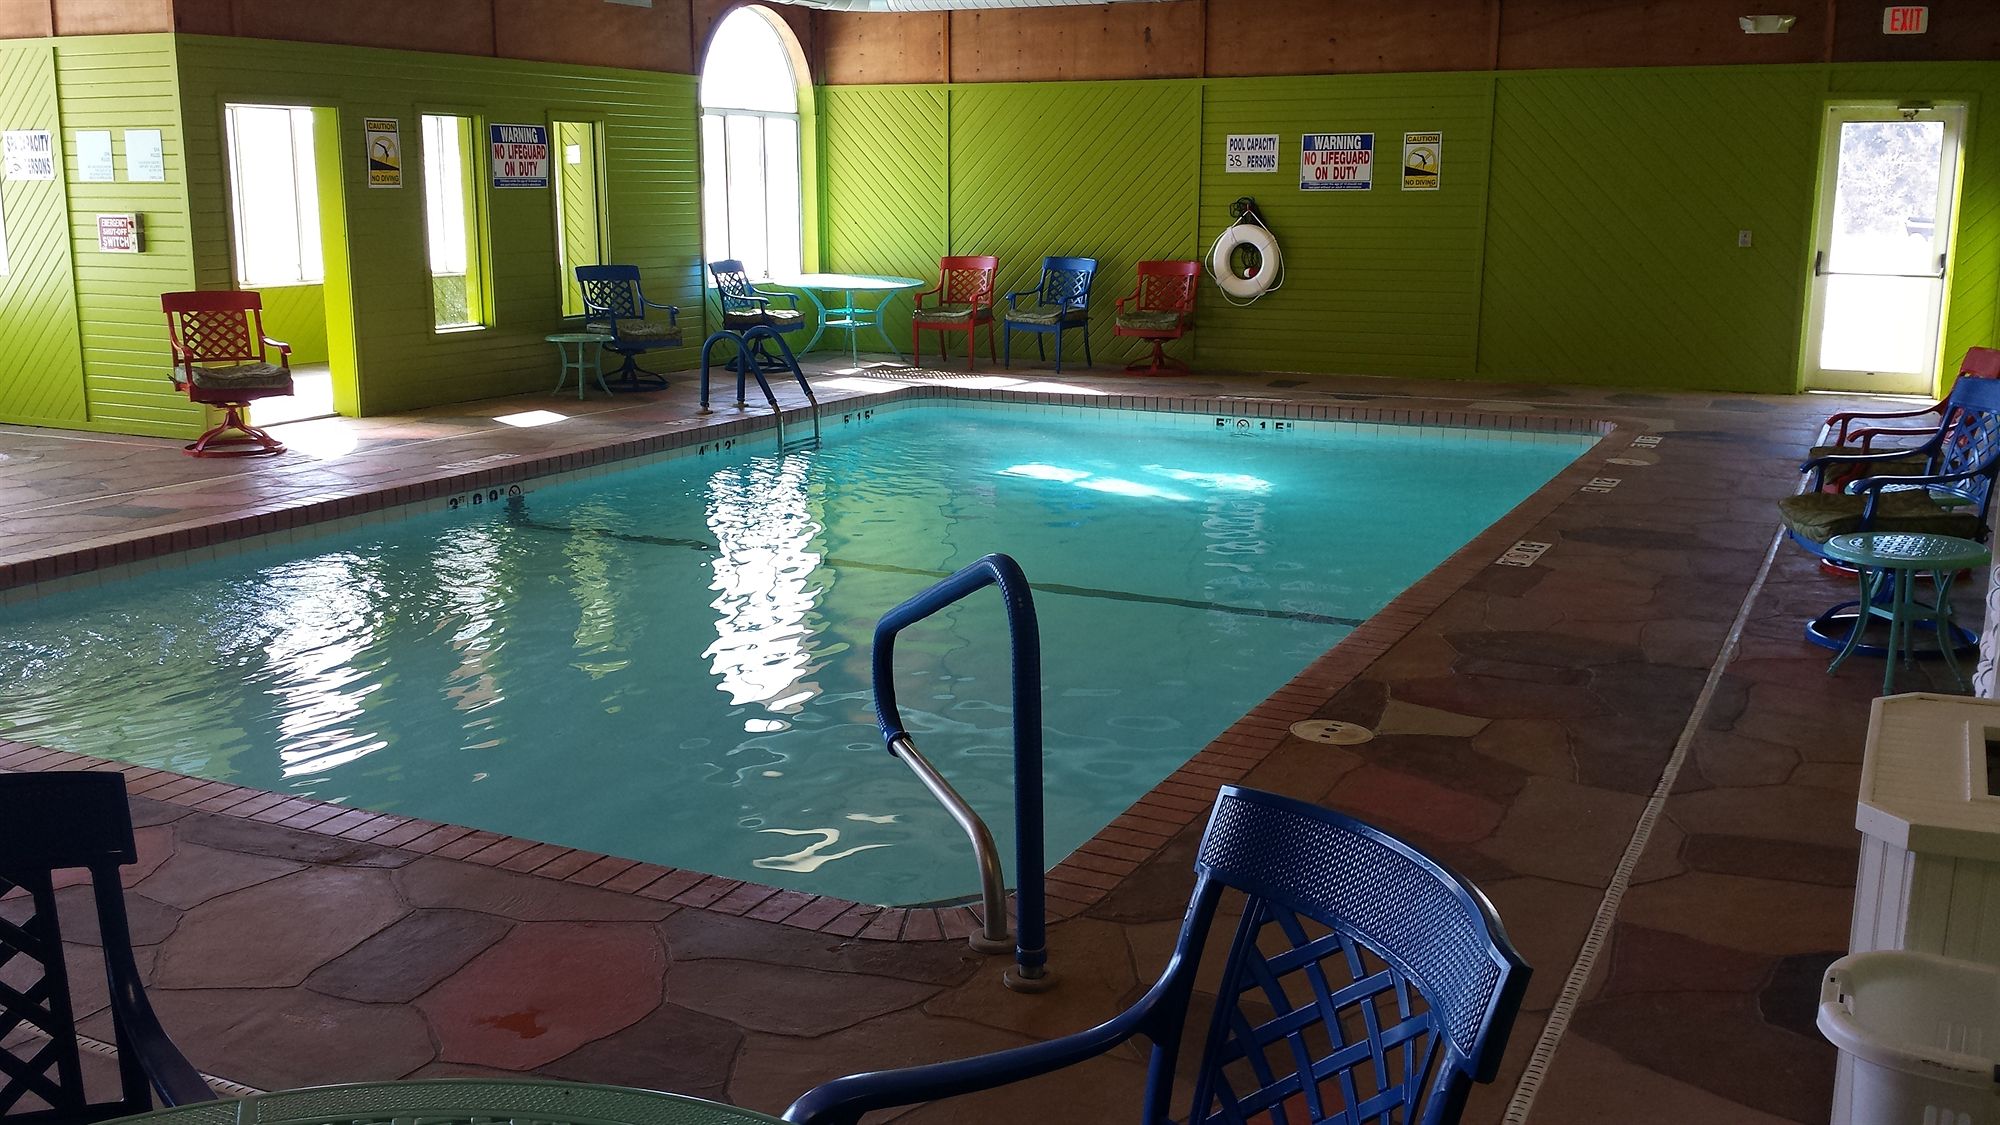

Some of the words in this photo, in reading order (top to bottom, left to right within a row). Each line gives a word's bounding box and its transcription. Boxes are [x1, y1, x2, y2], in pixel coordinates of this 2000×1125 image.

[1890, 8, 1923, 31] EXIT
[368, 122, 396, 131] CAUTION
[500, 126, 538, 143] WARNING
[1229, 138, 1245, 150] POOL
[1246, 137, 1277, 150] CAPACITY
[1314, 135, 1362, 150] WARNING
[494, 145, 506, 160] NO
[508, 145, 546, 160] LIFEGUARD
[1304, 151, 1317, 165] NO
[1321, 151, 1370, 165] LIFEGUARD
[1246, 155, 1275, 168] PERSONS
[505, 162, 516, 176] ON
[519, 162, 538, 176] DUTY
[1315, 167, 1328, 180] ON
[1333, 166, 1358, 180] DUTY
[371, 174, 380, 182] NO
[381, 175, 399, 183] DIVING
[102, 237, 130, 248] SWITCH
